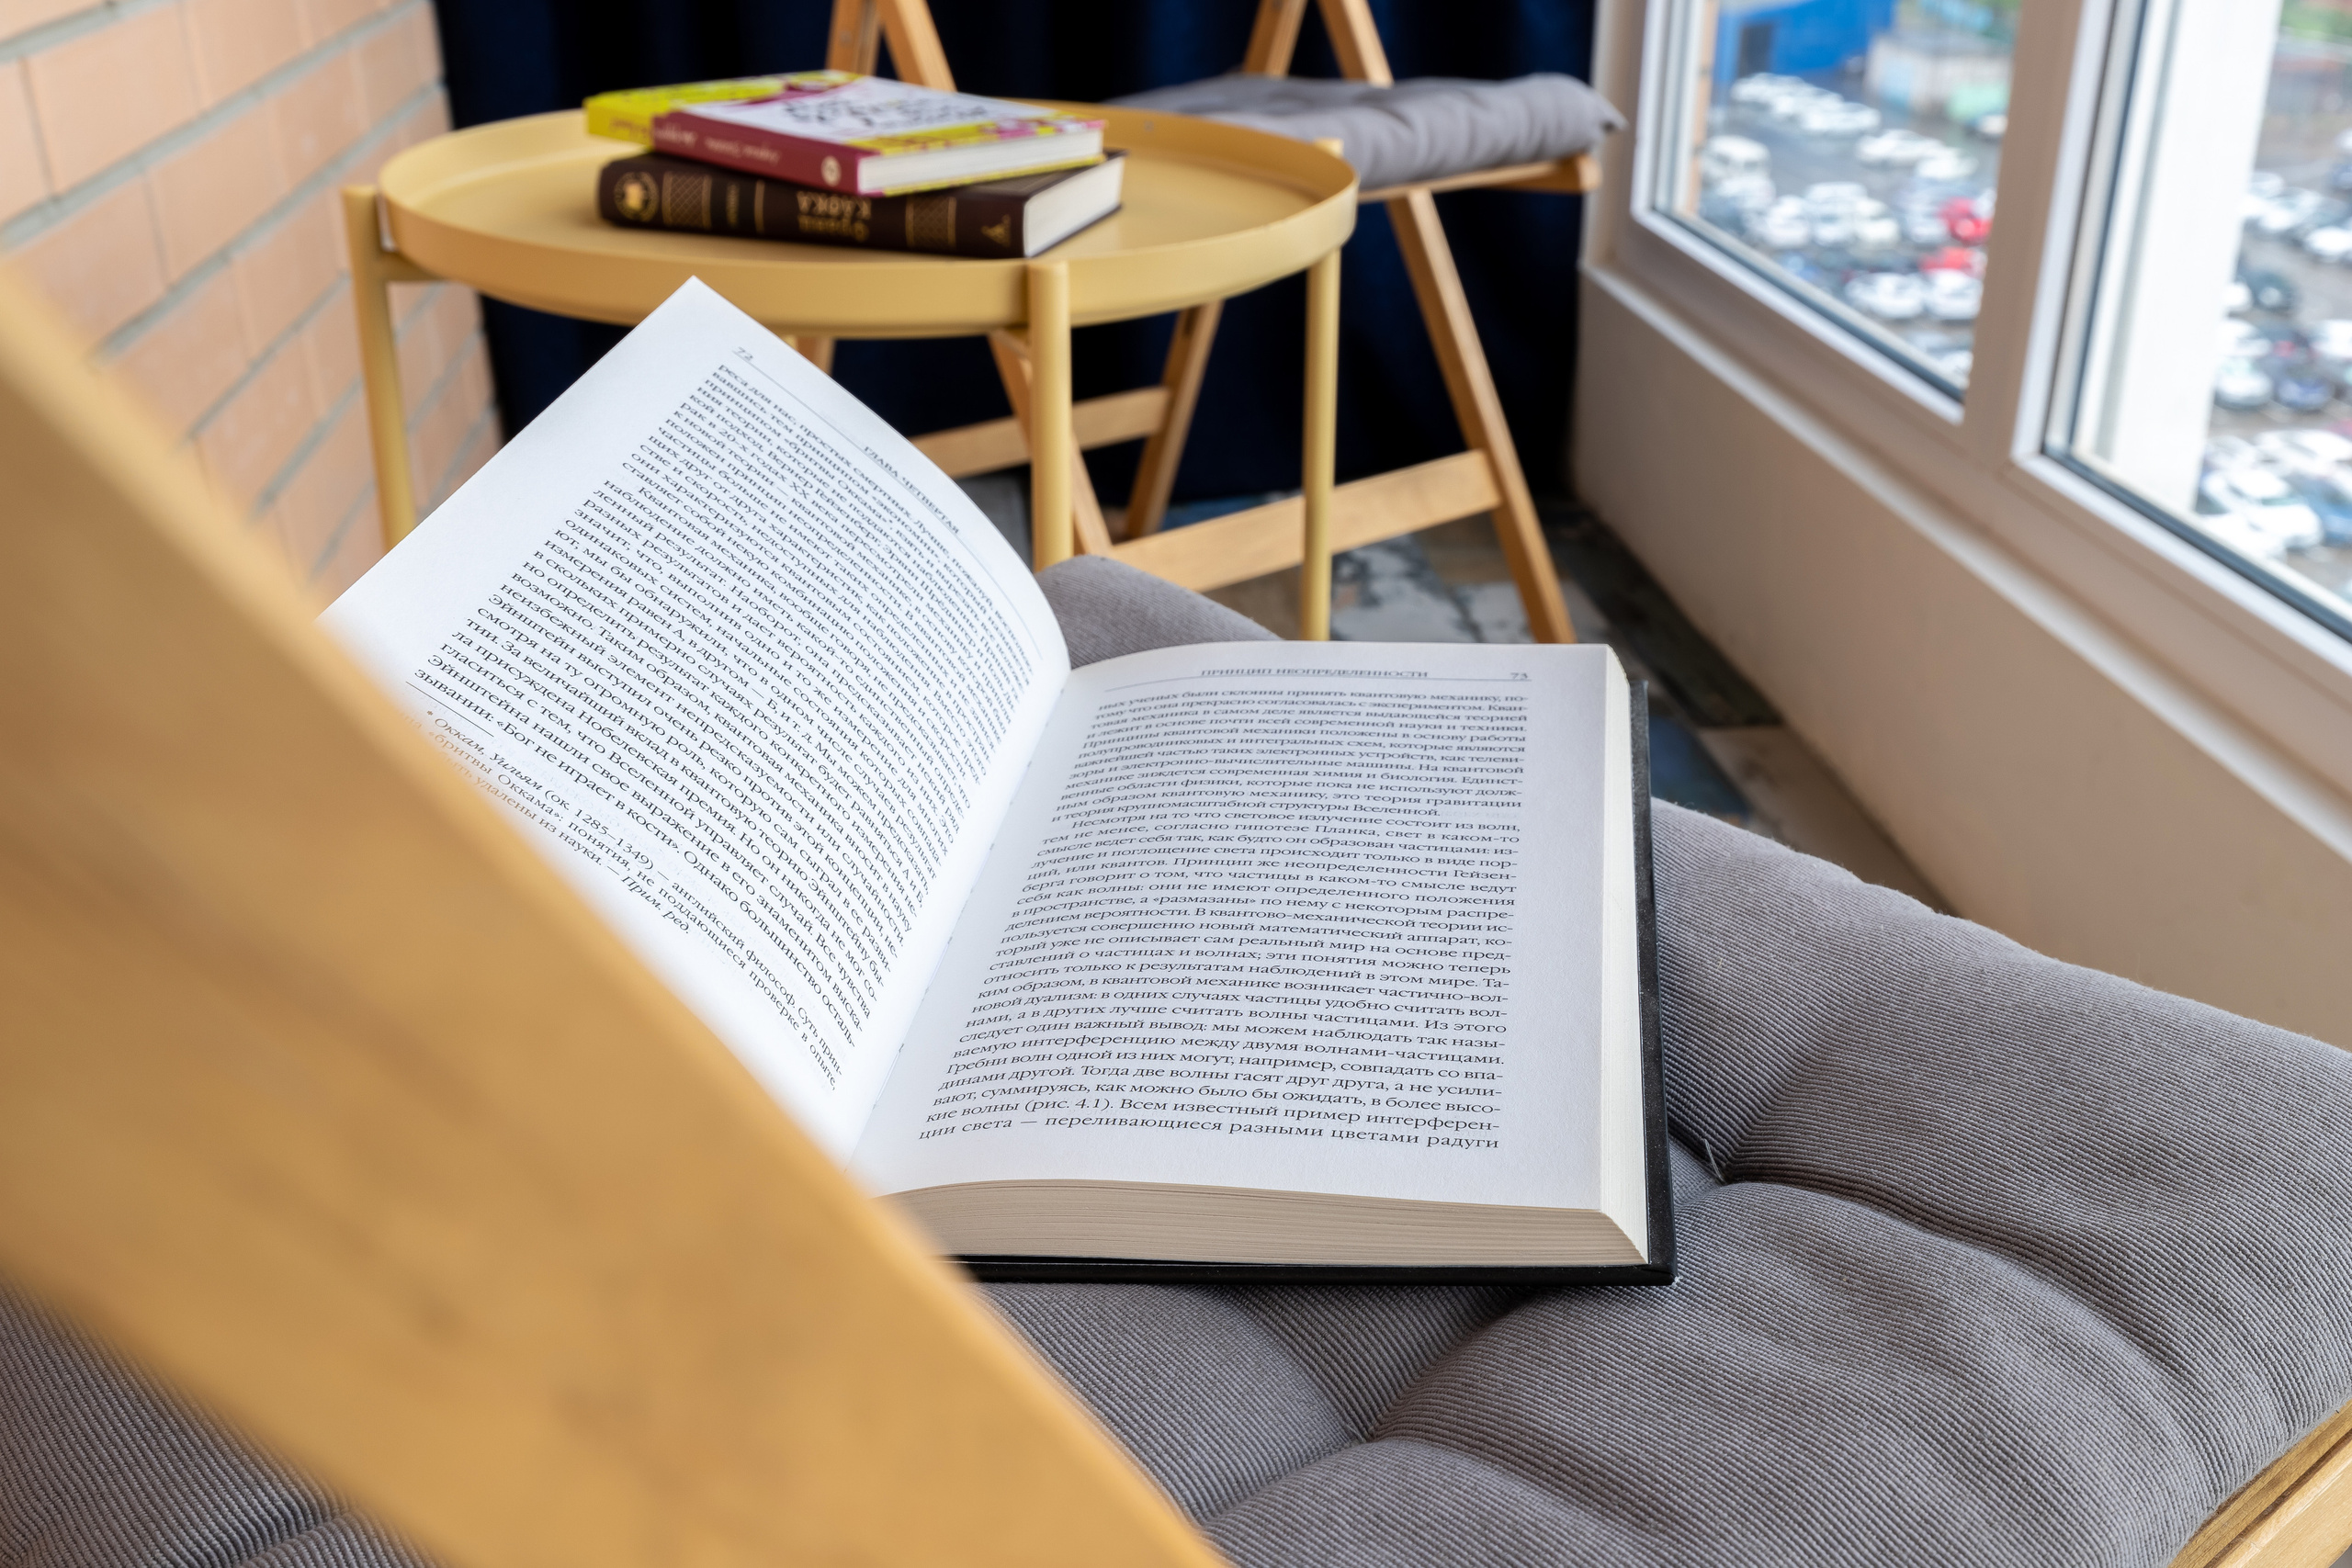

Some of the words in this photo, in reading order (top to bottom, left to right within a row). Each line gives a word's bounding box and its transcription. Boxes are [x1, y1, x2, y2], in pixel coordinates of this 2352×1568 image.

[734, 344, 754, 363] 72
[862, 445, 899, 478] ГЛАВА
[899, 475, 960, 535] ЧЕТВЕРТАЯ
[686, 393, 718, 416] кой
[713, 412, 763, 455] подход,
[764, 448, 815, 492] Вернер
[813, 486, 880, 548] Гейзенберг,
[881, 542, 920, 583] Эрвин
[918, 578, 978, 651] Шрёдингер
[982, 655, 1005, 694] Поль
[1001, 687, 1016, 716] Ди-
[1200, 668, 1274, 677] ПРИНЦИП
[1276, 668, 1428, 678] НЕОПРЕДЕЛЕННОСТИ
[1510, 671, 1529, 680] 73
[561, 517, 659, 587] одинаковых
[656, 582, 712, 629] систем,
[713, 624, 793, 689] начальные
[790, 684, 859, 753] состояния
[857, 749, 907, 810] которых
[904, 806, 942, 868] совпада-
[1097, 700, 1126, 712] ных
[1126, 693, 1180, 707] ученых
[1180, 690, 1219, 699] были
[1285, 690, 1347, 698] принять
[1349, 691, 1427, 702] квантовую
[1429, 694, 1501, 704] механику,
[1081, 731, 1160, 750] Принципы
[1161, 726, 1240, 738] квантовой
[1318, 728, 1398, 739] положены
[1412, 732, 1466, 743] основу
[1468, 733, 1526, 743] работы
[498, 582, 609, 657] неизбежный
[605, 652, 676, 706] элемент
[673, 701, 816, 826] непредсказуемости
[814, 821, 842, 854] или
[839, 849, 904, 950] случайности.
[1064, 773, 1135, 791] механике
[1136, 768, 1206, 779] зиждется
[1208, 768, 1309, 777] современная
[1312, 770, 1363, 779] химия
[1379, 771, 1459, 784] биология.
[1461, 774, 1524, 785] Единст-
[475, 604, 539, 650] смотря
[537, 646, 563, 665] на
[560, 660, 583, 682] ту
[581, 674, 668, 739] огромную
[664, 733, 706, 772] роль,
[707, 765, 774, 826] которую
[771, 820, 799, 851] сам
[797, 846, 843, 900] сыграл
[848, 905, 865, 929] ее
[860, 923, 890, 974] разви-
[1062, 806, 1114, 821] теория
[1115, 798, 1267, 814] крупномасштабной
[1268, 801, 1350, 813] структуры
[1352, 802, 1442, 817] Вселенной.
[424, 651, 531, 726] Эйнштейна
[529, 721, 591, 766] нашли
[588, 761, 630, 795] свое
[628, 789, 720, 865] выражение
[729, 869, 757, 898] его
[754, 892, 832, 986] знаменитом
[830, 981, 862, 1033] выска-
[439, 640, 526, 701] гласиться
[536, 704, 571, 736] тем,
[573, 728, 608, 756] что
[606, 748, 698, 821] Вселенной
[693, 816, 770, 886] управляет
[766, 881, 815, 937] случай.
[814, 930, 837, 964] Все
[834, 959, 871, 1021] чувства
[1042, 833, 1070, 845] тем
[1072, 829, 1093, 840] не
[1096, 825, 1148, 837] менее,
[1152, 822, 1230, 831] согласно
[1233, 823, 1309, 833] гипотезе
[1314, 823, 1380, 838] Планка,
[1385, 829, 1422, 840] свет
[1441, 832, 1520, 844] каком-то
[1025, 865, 1060, 882] ций,
[1064, 863, 1097, 874] или
[1099, 858, 1170, 870] квантов.
[1172, 855, 1253, 867] Принцип
[1256, 859, 1280, 868] же
[1283, 860, 1448, 877] неопределенности
[1453, 867, 1518, 880] Гейзен-
[433, 713, 484, 756] Оккам,
[488, 750, 544, 793] Уильям
[541, 785, 569, 812] (ок.
[670, 880, 747, 952] английский
[742, 943, 797, 1011] философ.
[795, 1003, 820, 1041] Суть
[817, 1035, 842, 1076] прин-
[494, 771, 565, 823] Оккама»:
[566, 820, 630, 873] понятия,
[635, 869, 656, 888] не
[656, 886, 747, 971] поддающиеся
[747, 968, 800, 1033] проверке
[807, 1041, 838, 1089] опыте,
[999, 924, 1088, 946] пользуется
[1089, 921, 1195, 932] совершенно
[1198, 920, 1256, 932] новый
[1258, 923, 1403, 942] математический
[1406, 933, 1480, 947] аппарат,
[1484, 937, 1513, 947] ко-
[987, 948, 1077, 974] ставлений
[1092, 948, 1175, 958] частицах
[1193, 949, 1262, 961] волнах;
[1264, 951, 1296, 962] эти
[1300, 953, 1376, 966] понятия
[1381, 958, 1444, 972] можно
[1447, 963, 1510, 976] теперь
[964, 1012, 1012, 1032] нами,
[1042, 1005, 1107, 1020] других
[1109, 1005, 1168, 1017] лучше
[1170, 1005, 1244, 1018] считать
[1248, 1009, 1307, 1021] волны
[1312, 1012, 1419, 1029] частицами.
[1424, 1017, 1449, 1031] Из
[1453, 1021, 1507, 1033] этого
[951, 1040, 1018, 1061] ваемую
[1020, 1032, 1177, 1049] интерференцию
[1180, 1037, 1239, 1052] между
[1241, 1040, 1299, 1054] двумя
[1303, 1043, 1504, 1066] волнами-частицами.
[919, 1126, 956, 1139] ции
[958, 1119, 1013, 1136] света
[1045, 1116, 1222, 1132] переливающиеся
[1227, 1122, 1323, 1138] разными
[1329, 1128, 1419, 1145] цветами
[1426, 1134, 1498, 1151] радуги
